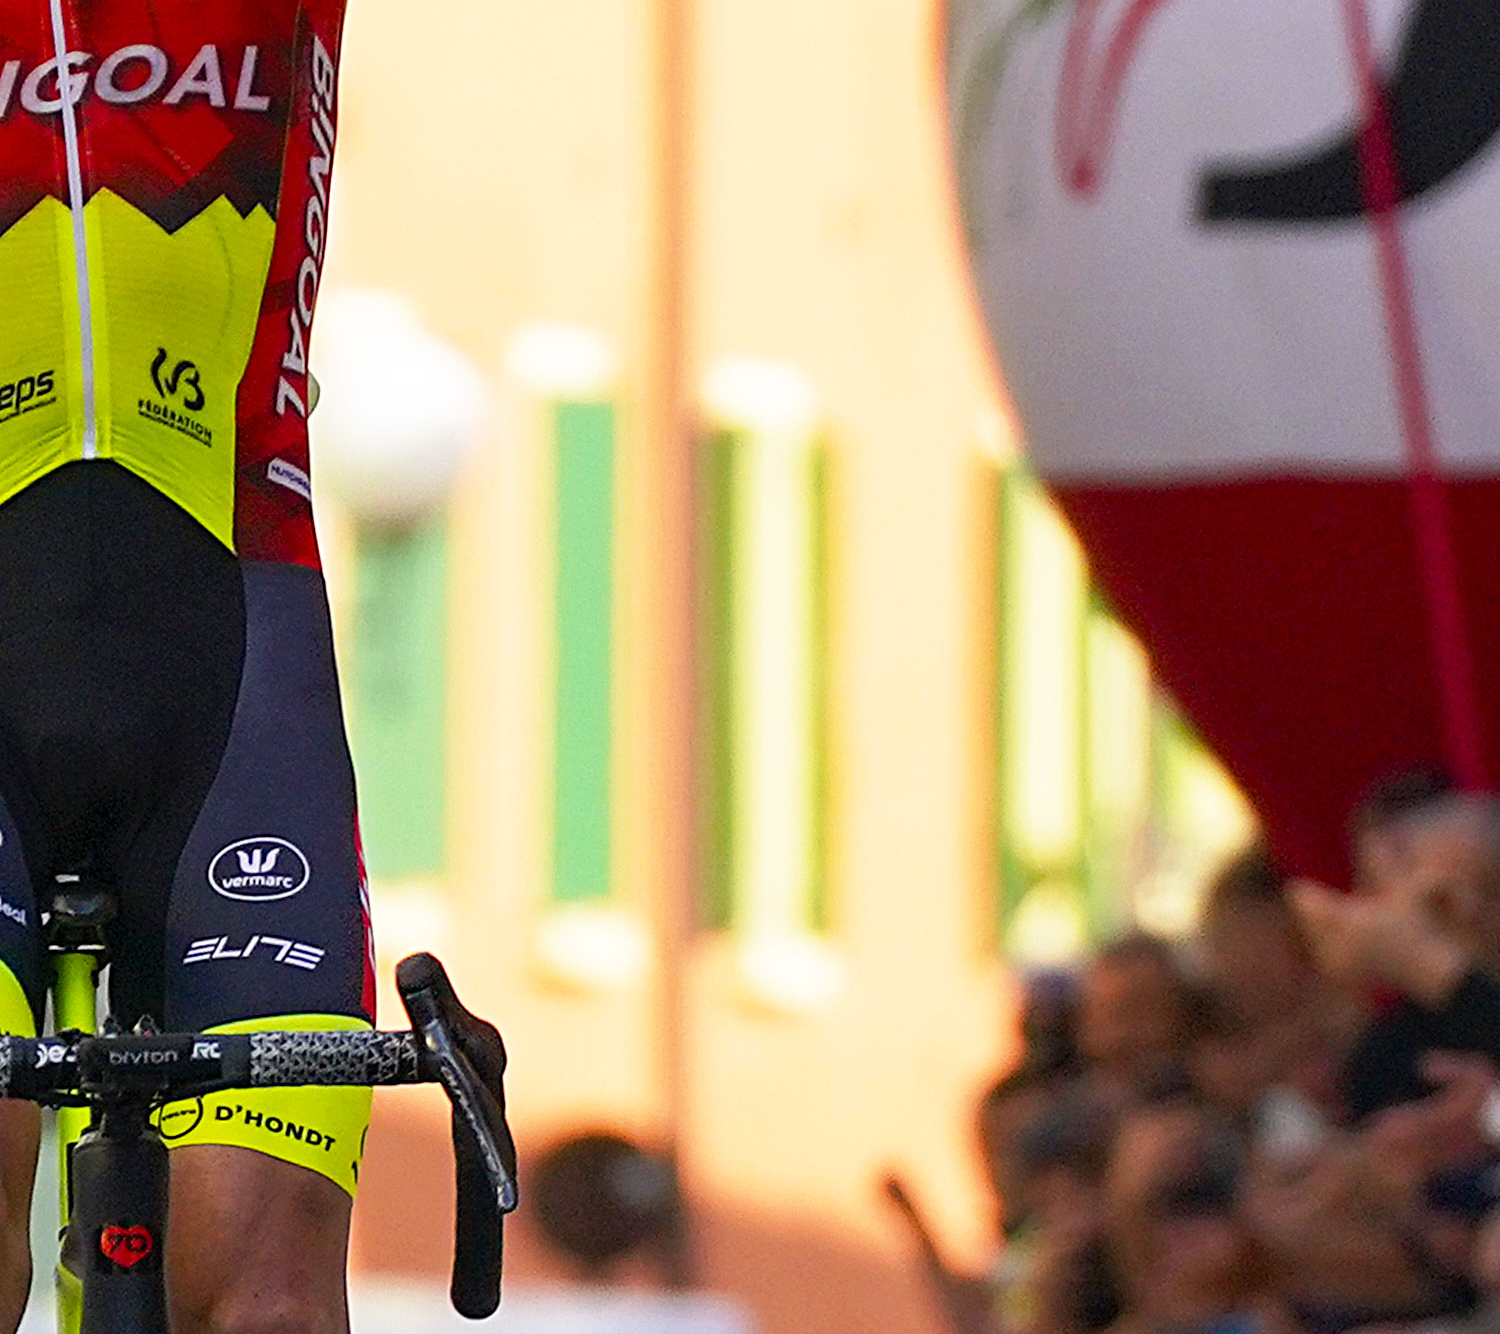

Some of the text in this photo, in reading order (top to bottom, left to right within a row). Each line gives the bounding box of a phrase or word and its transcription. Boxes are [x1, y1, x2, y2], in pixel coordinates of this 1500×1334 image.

[222, 875, 293, 889] vermarc
[183, 935, 326, 970] ELITE
[214, 1105, 337, 1153] D'HONDT
